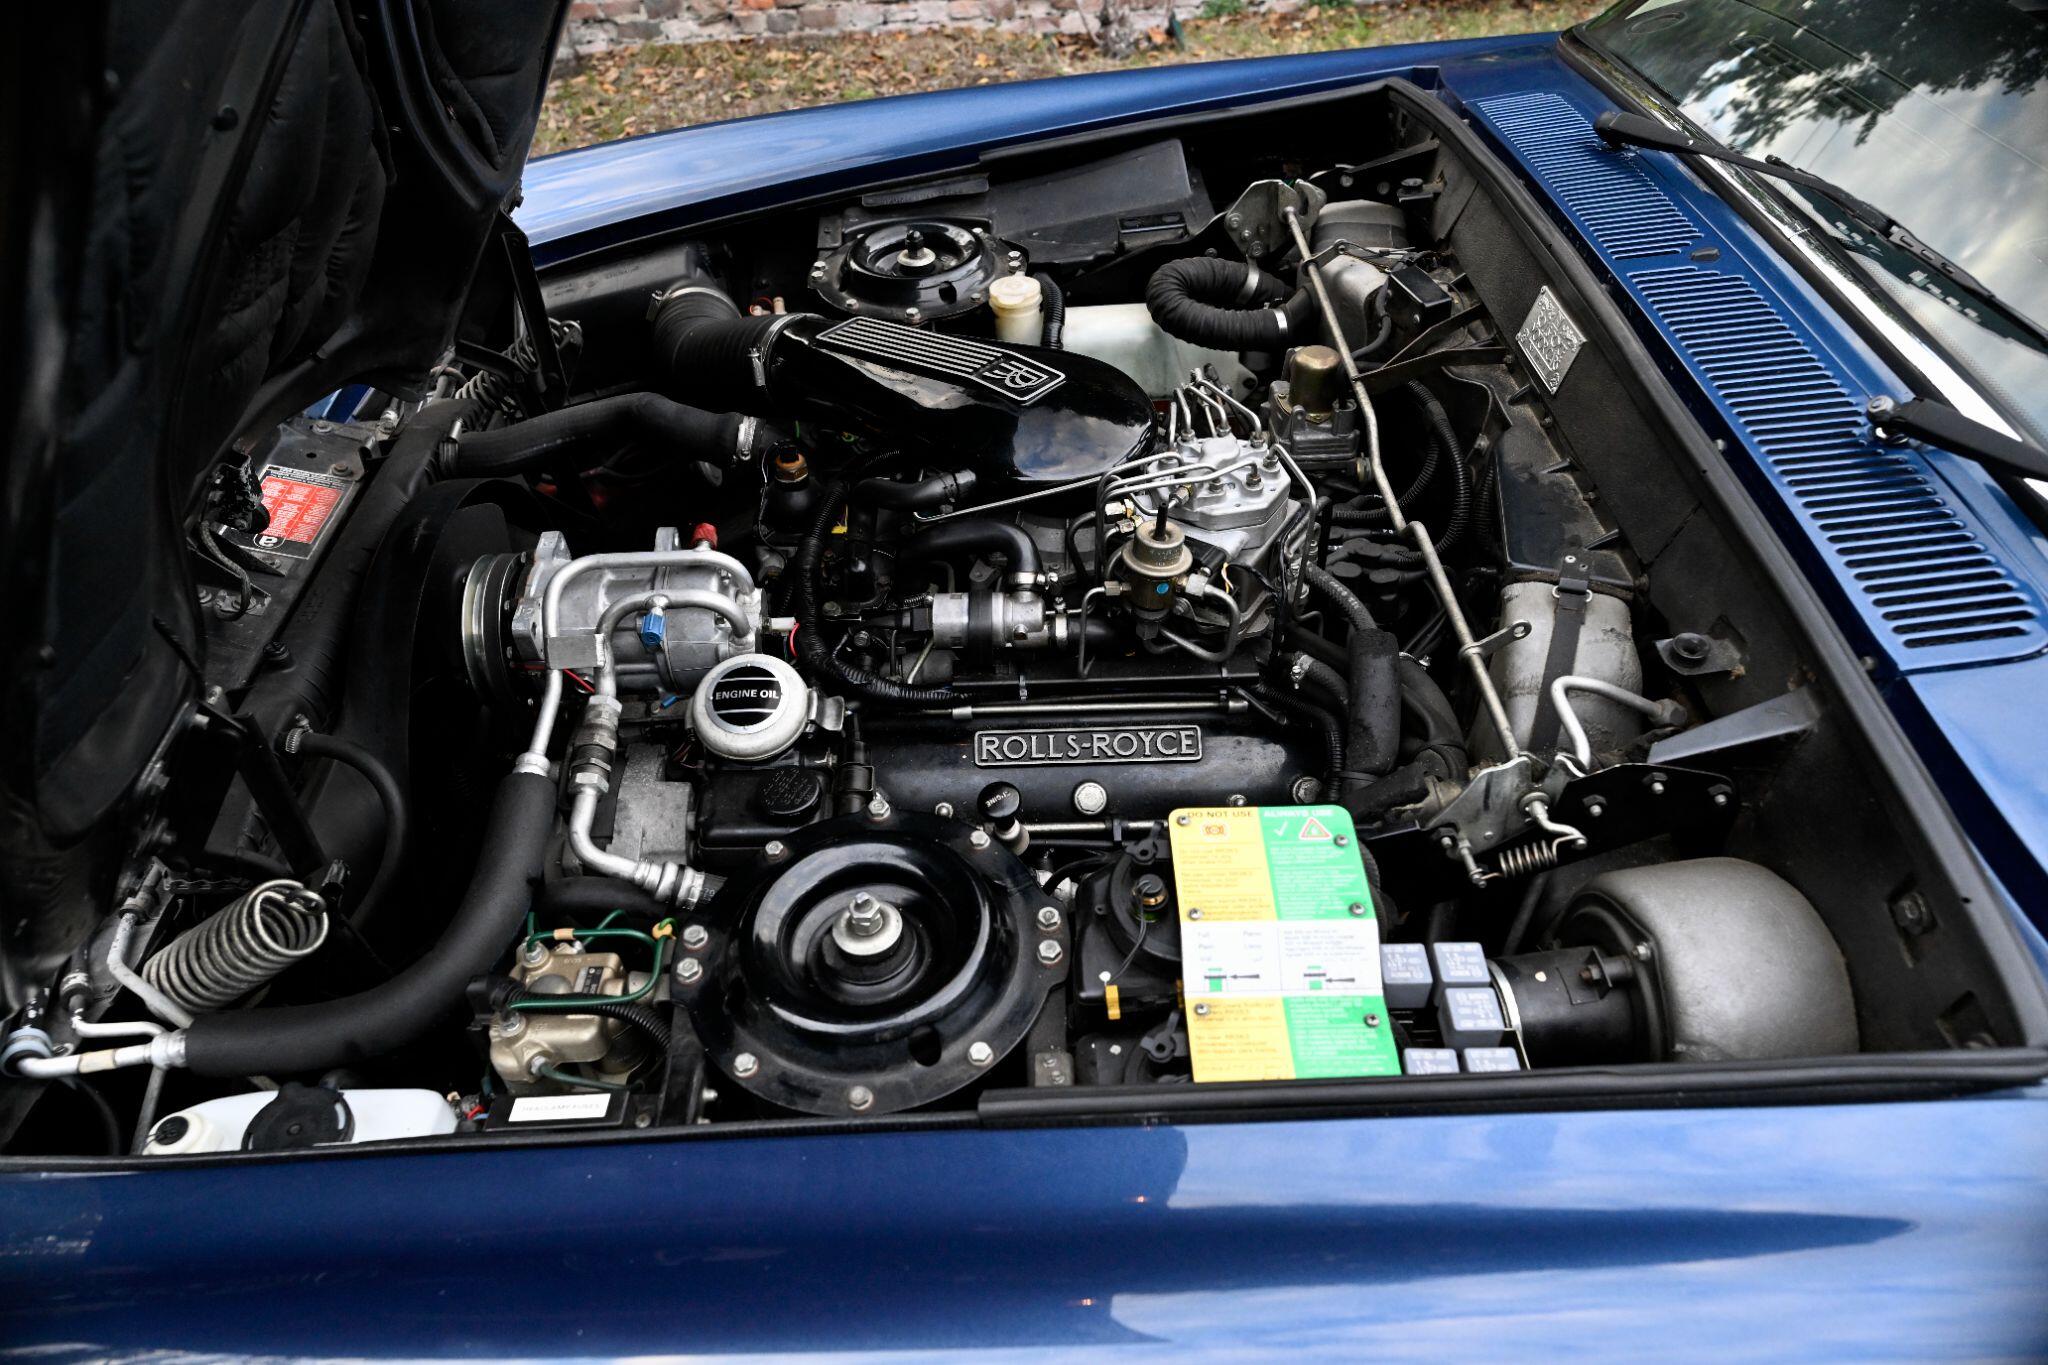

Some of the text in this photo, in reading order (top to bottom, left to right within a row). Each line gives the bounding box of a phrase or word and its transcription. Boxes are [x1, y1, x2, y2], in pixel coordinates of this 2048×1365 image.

[715, 688, 780, 700] ENGINE OIL
[980, 730, 1197, 760] ROLLS-ROYCE
[1206, 810, 1228, 818] NOT
[1232, 810, 1252, 818] USE
